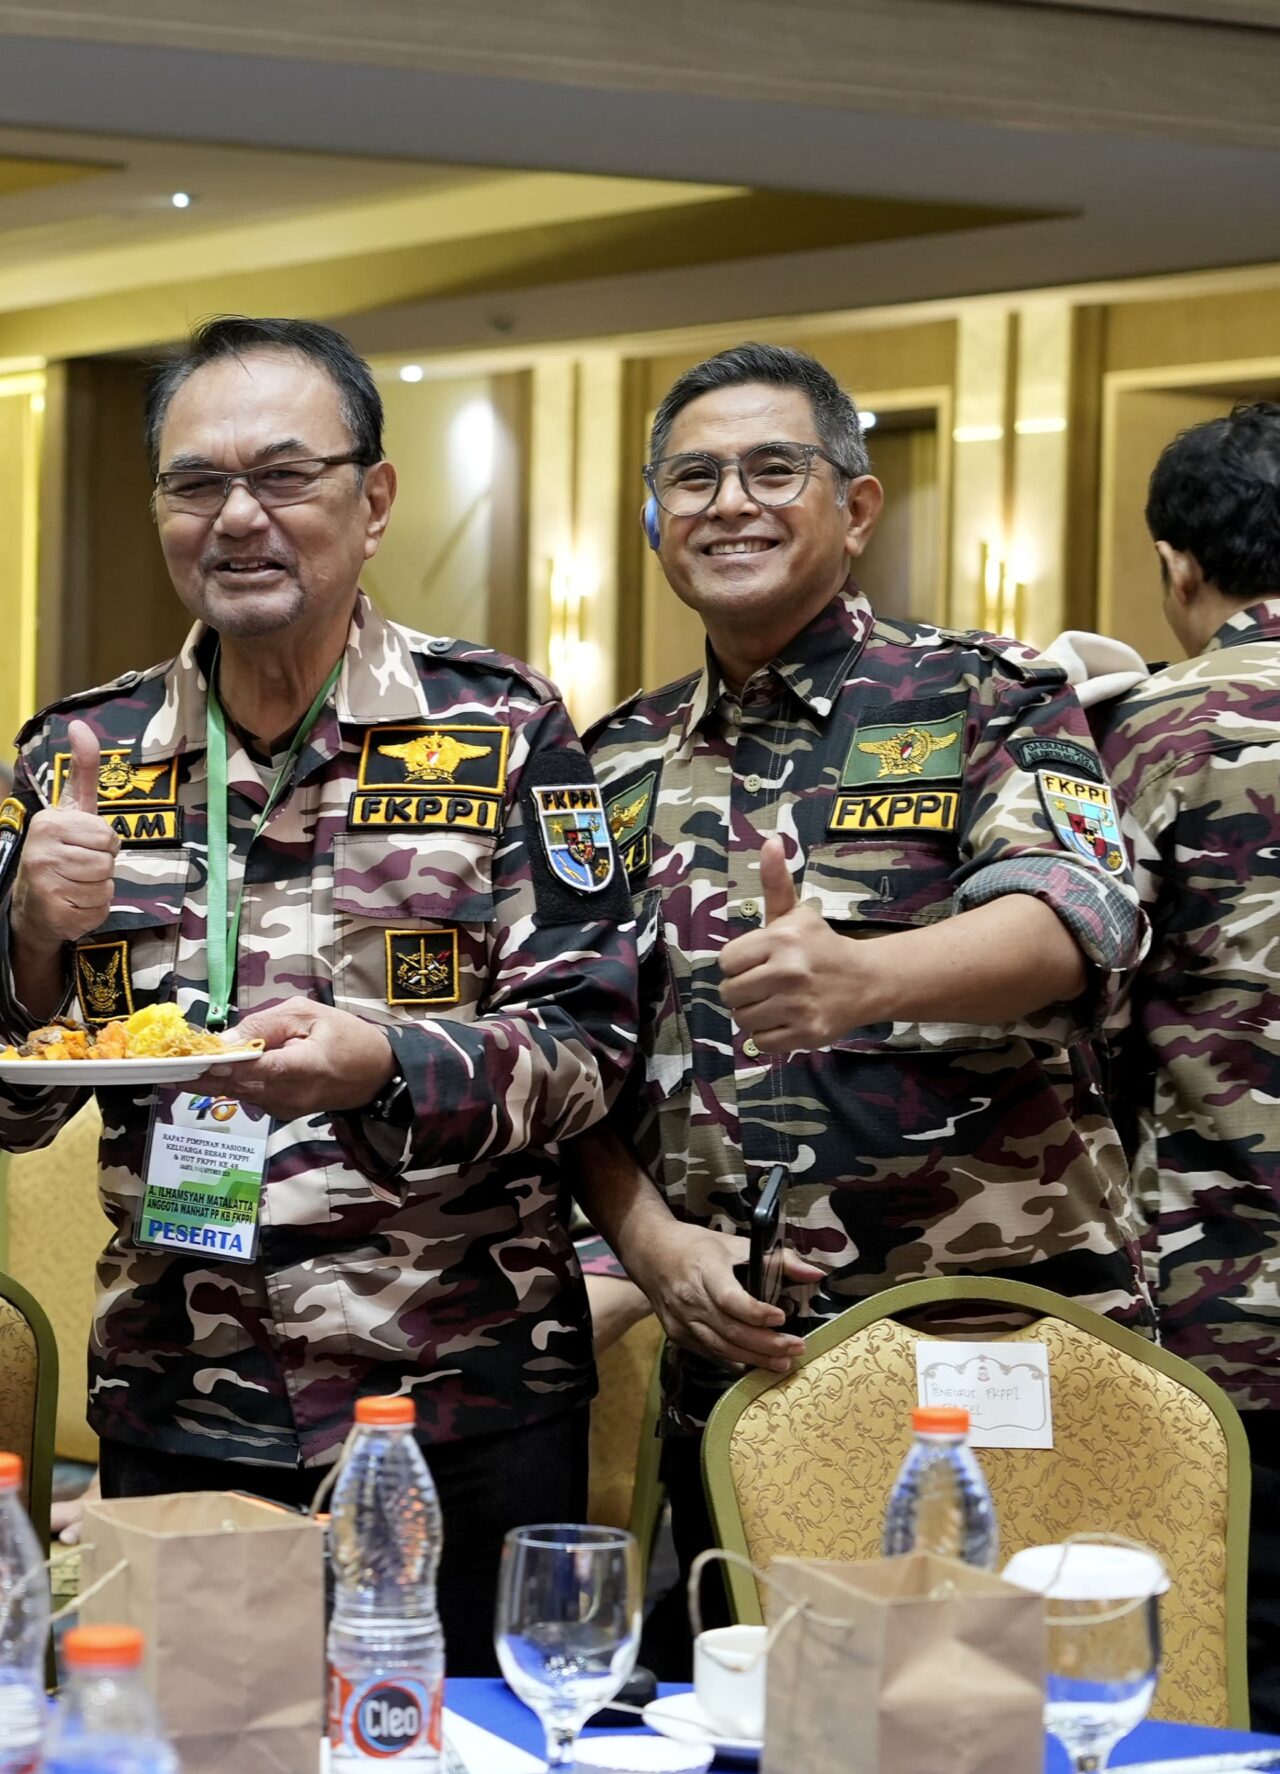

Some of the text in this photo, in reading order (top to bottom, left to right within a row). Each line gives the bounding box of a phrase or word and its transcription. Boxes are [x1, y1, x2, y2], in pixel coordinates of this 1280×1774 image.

[541, 790, 597, 810] FKPPI
[1045, 776, 1107, 804] FKPPI
[361, 798, 488, 826] FKPPI
[836, 795, 953, 827] FKPPI
[111, 814, 166, 838] AM
[162, 1133, 255, 1154] RAPAT PIMPINAN NASIONAL
[166, 1143, 250, 1163] KELUARGA BESAR FKPPI
[180, 1155, 195, 1163] HUT
[196, 1157, 218, 1167] FKPPI
[147, 1198, 252, 1225] ANGGOTA WANHAT PP KB FKPPI
[149, 1186, 253, 1212] A. ILHAMSYAH MATALATTA
[148, 1219, 243, 1252] PESERTA
[365, 1700, 419, 1738] Cleo
